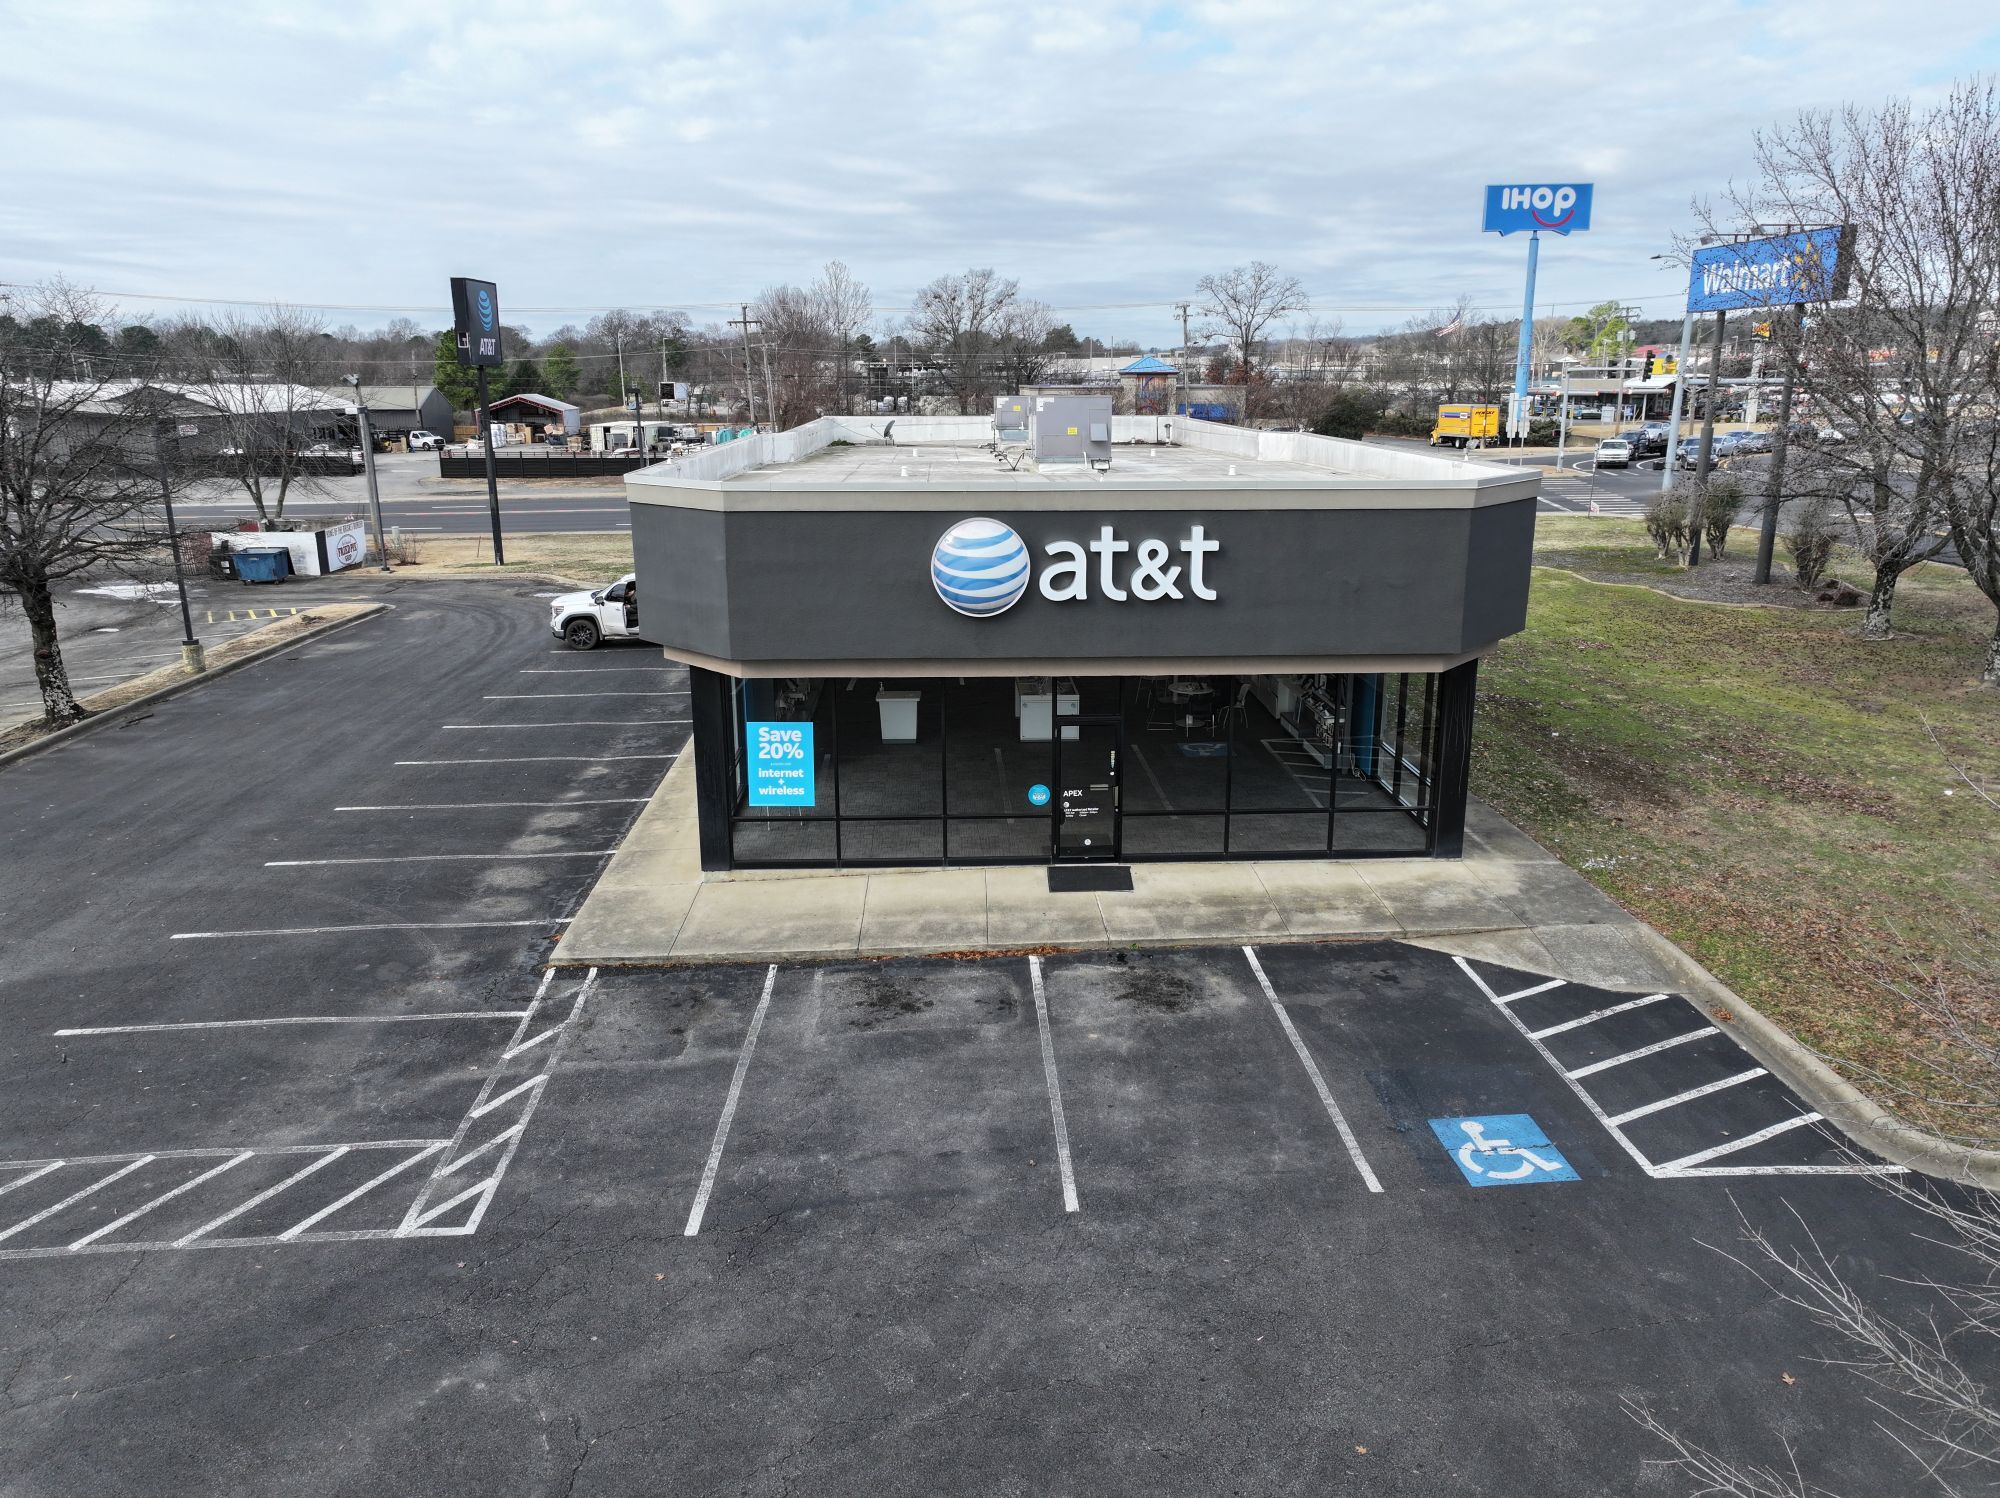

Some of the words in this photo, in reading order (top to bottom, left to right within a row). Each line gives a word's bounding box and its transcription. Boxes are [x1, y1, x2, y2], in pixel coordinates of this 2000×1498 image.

[1703, 254, 1791, 296] Walmart
[479, 337, 496, 356] AT&T
[1039, 524, 1220, 602] at&t
[758, 727, 802, 742] Save
[758, 743, 804, 759] 20%
[758, 768, 804, 778] internet
[758, 785, 805, 795] wireless
[1063, 789, 1083, 797] APEX
